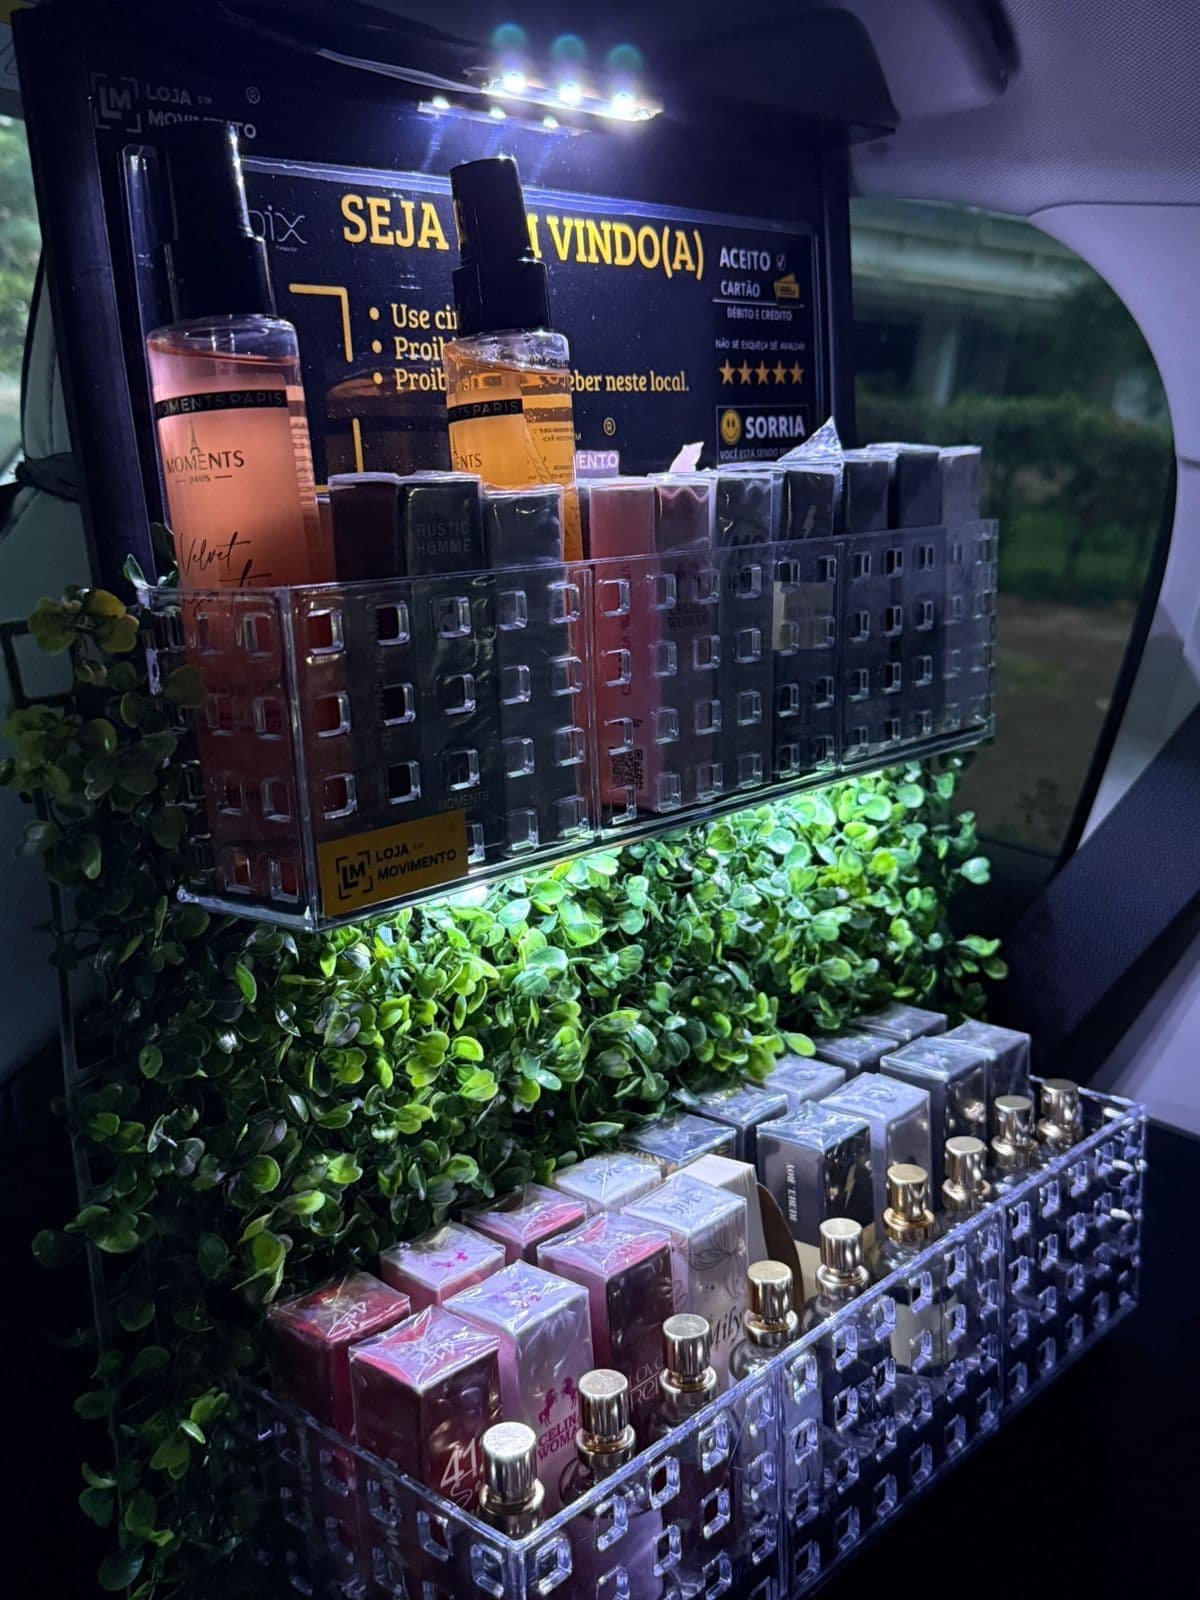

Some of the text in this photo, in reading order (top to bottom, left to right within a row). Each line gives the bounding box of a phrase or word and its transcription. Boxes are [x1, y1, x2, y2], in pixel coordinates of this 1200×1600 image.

[146, 82, 192, 106] LOJA
[341, 194, 449, 250] SEJA
[547, 217, 705, 281] VINDO(A)
[720, 247, 772, 272] ACEITO
[720, 279, 761, 298] CARTÃO
[390, 303, 431, 330] Use
[755, 308, 761, 320] E
[605, 374, 647, 392] neste
[649, 369, 691, 393] local.
[230, 390, 284, 408] PARIS
[472, 400, 520, 417] PARIS
[744, 414, 806, 440] SORRIA
[165, 449, 246, 475] MOMENTS
[188, 474, 211, 485] PARIS
[415, 519, 471, 537] RUSTIC
[179, 531, 252, 577] Velvet
[376, 843, 410, 862] LOJA
[377, 848, 458, 880] MOVIMENTO
[342, 861, 366, 890] LM
[538, 1411, 577, 1447] CELIN
